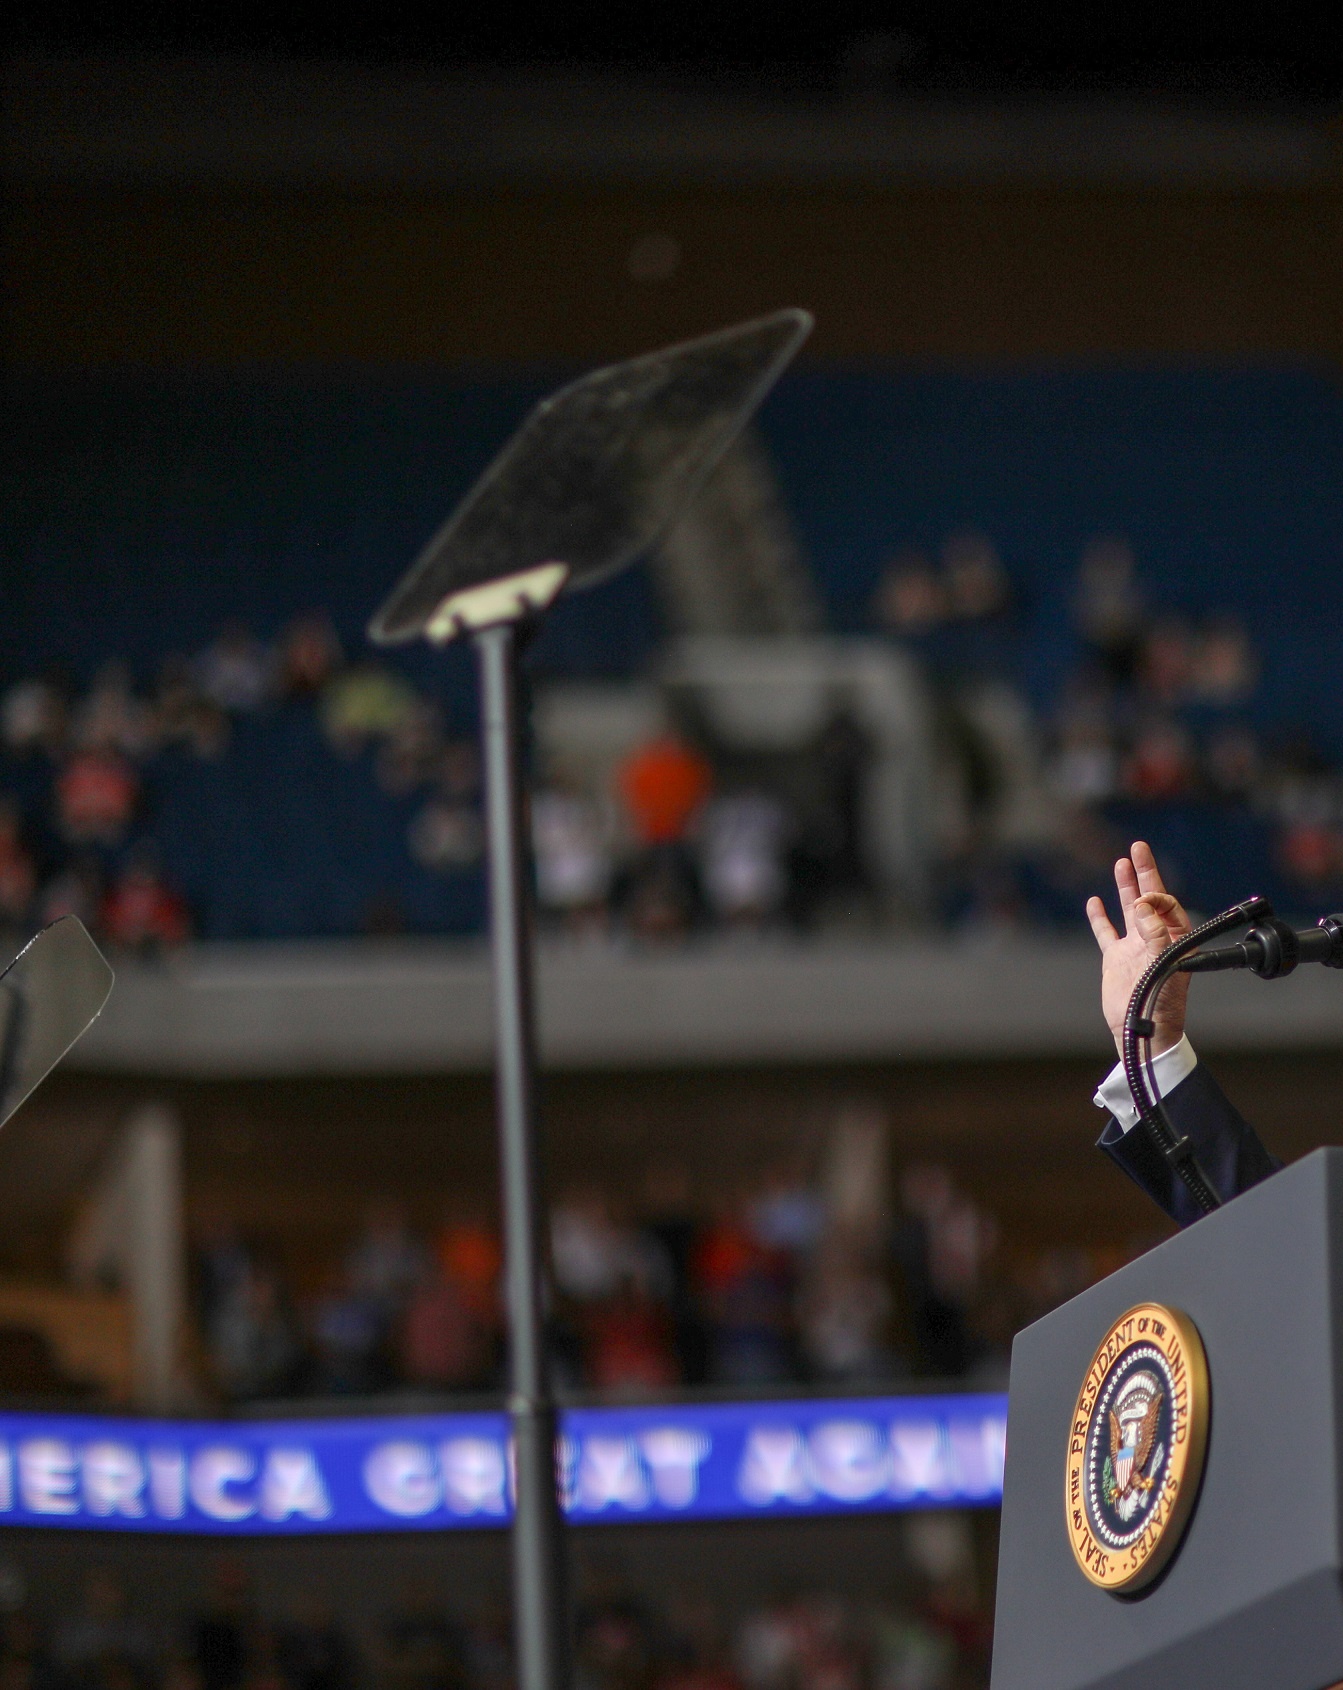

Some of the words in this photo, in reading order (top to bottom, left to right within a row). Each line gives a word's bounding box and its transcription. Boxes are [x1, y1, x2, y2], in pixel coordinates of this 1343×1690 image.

[1137, 1317, 1150, 1333] OF
[1151, 1319, 1167, 1341] THE
[1071, 1318, 1135, 1455] PRESIDENT
[1167, 1334, 1188, 1444] UNITED
[0, 1434, 336, 1523] ERICA
[1071, 1467, 1080, 1505] THE
[1079, 1526, 1109, 1578] SEAL
[1130, 1476, 1177, 1569] STATES
